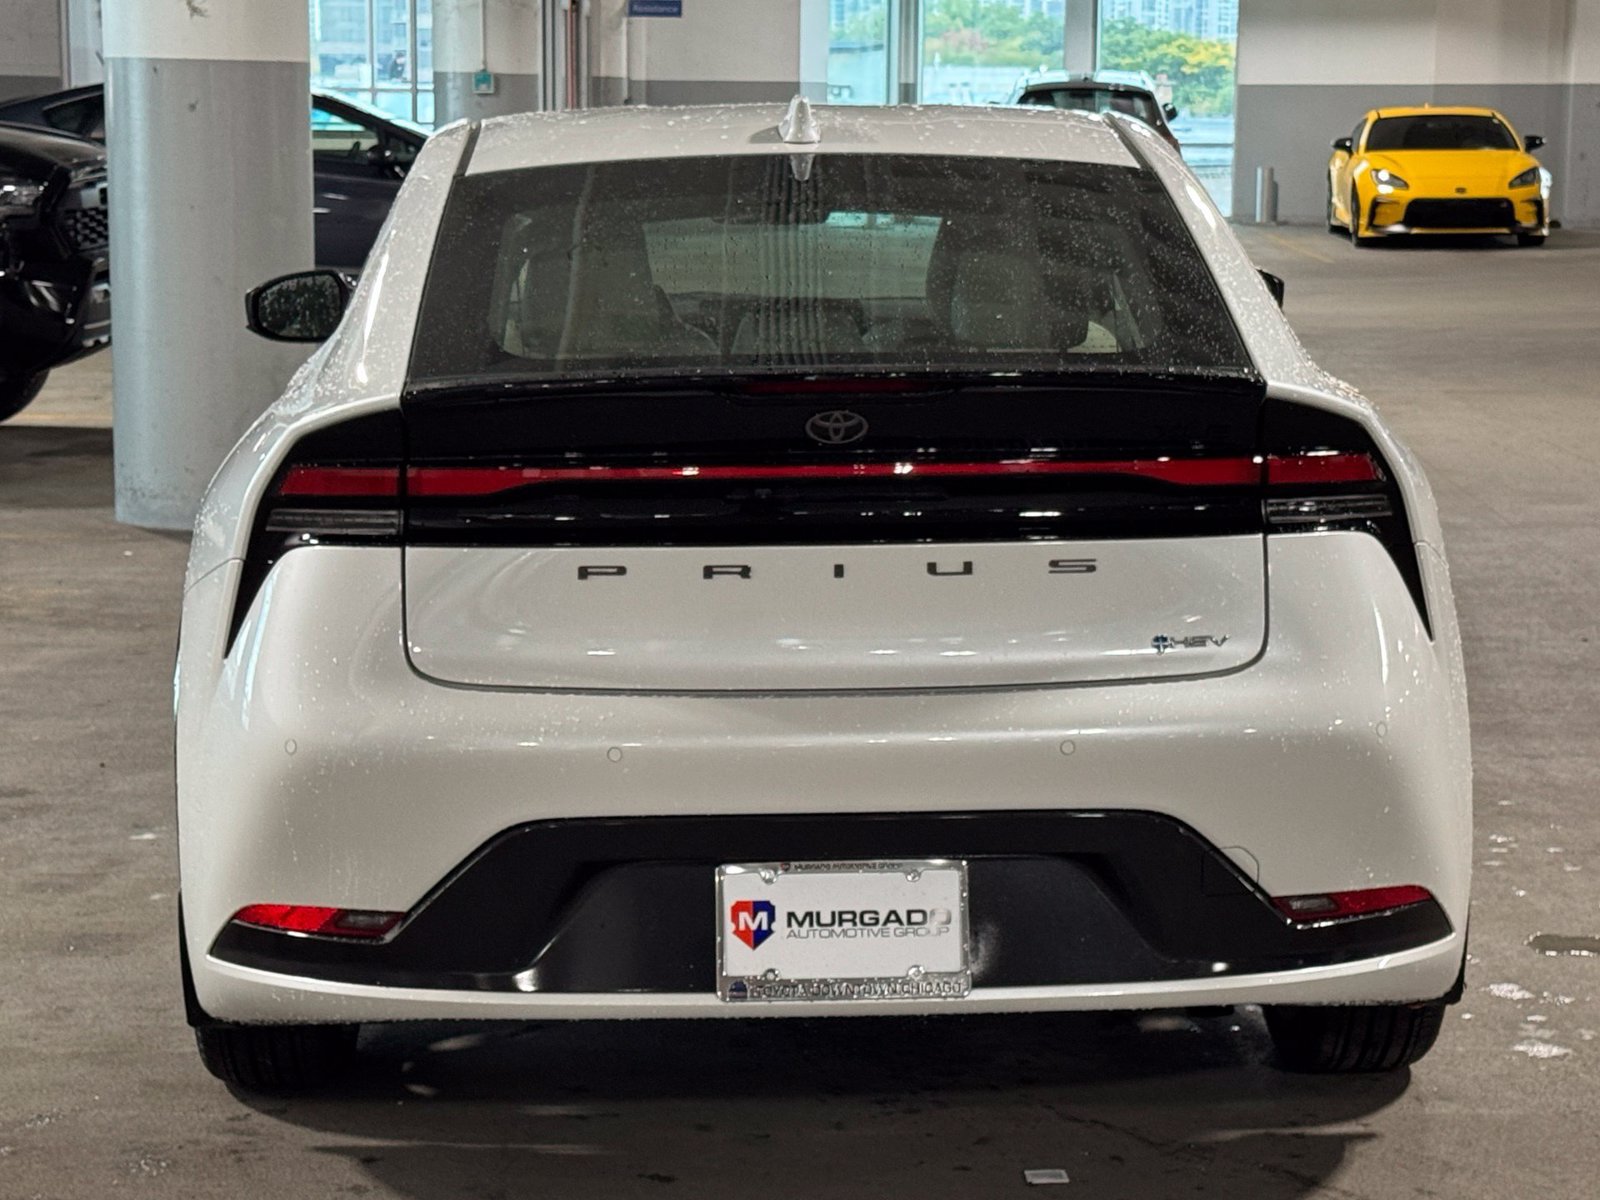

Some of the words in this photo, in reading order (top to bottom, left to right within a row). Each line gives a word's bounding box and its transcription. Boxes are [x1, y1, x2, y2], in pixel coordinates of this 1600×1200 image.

[577, 558, 1097, 580] PRIUS
[738, 911, 768, 931] M
[786, 908, 952, 928] MURGADO
[786, 927, 891, 939] AUTOMOTIVE
[893, 926, 951, 938] GROUP
[757, 984, 807, 996] TOYOTA
[902, 981, 962, 994] CHICAGO
